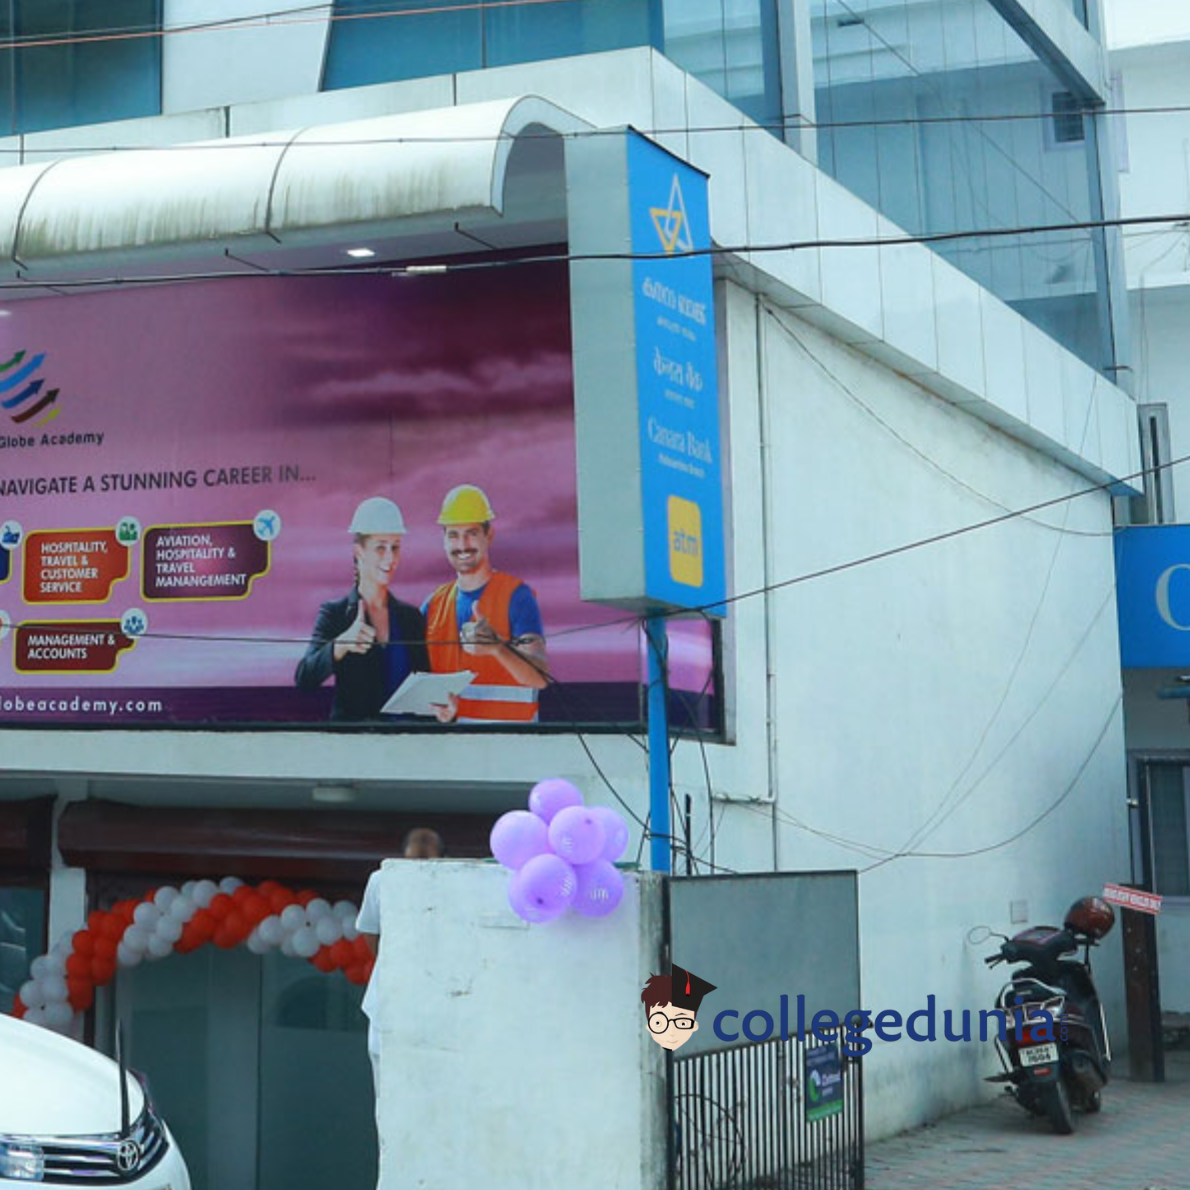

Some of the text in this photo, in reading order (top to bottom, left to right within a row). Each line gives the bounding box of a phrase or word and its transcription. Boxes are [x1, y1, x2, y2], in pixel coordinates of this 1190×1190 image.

[40, 430, 105, 446] Academy
[647, 415, 713, 465] Canara Bank
[82, 475, 96, 493] A
[100, 470, 198, 492] STUNNING
[203, 465, 273, 487] CAREER
[278, 463, 317, 484] IN...
[155, 546, 237, 560] HOSPITALITY &
[40, 554, 89, 567] TRAVEL &
[40, 567, 99, 580] CUSTOMER
[155, 561, 196, 575] TRAVEL
[39, 581, 84, 594] SERVICE
[27, 633, 116, 647] MANAGEMENT &
[27, 647, 88, 660] ACCOUNTS
